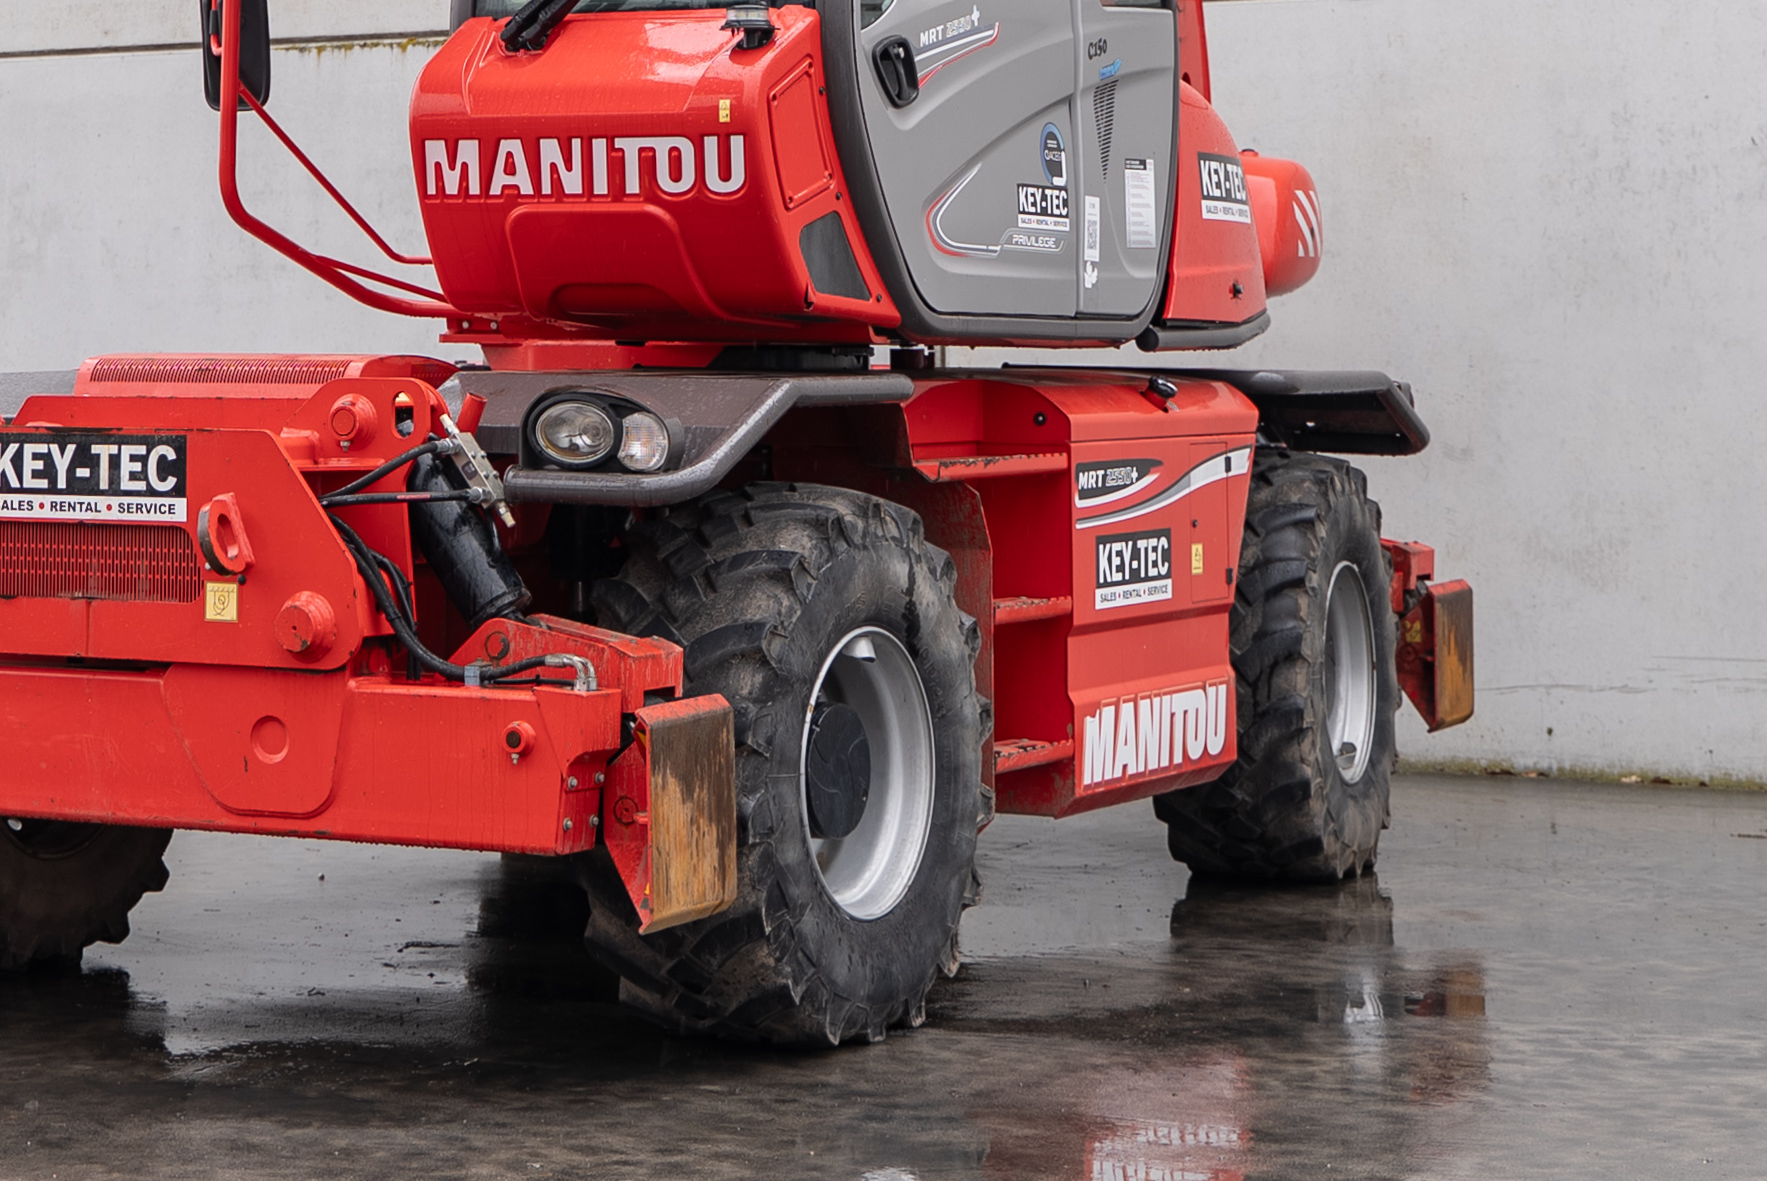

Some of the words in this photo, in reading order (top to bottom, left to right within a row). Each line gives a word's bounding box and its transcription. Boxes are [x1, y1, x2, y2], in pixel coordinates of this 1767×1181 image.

[919, 24, 945, 48] MRT
[1087, 37, 1108, 60] C150
[424, 135, 746, 196] MANITOU
[1199, 159, 1247, 202] KEY-TEC
[1018, 185, 1068, 216] KEY-TEC
[1011, 234, 1057, 248] PRIVILEGE
[1078, 469, 1105, 491] MRT
[49, 500, 102, 513] RENTAL
[117, 502, 176, 515] SERVICE
[1098, 536, 1169, 584] KEY-TEC
[1099, 592, 1117, 603] SALES
[1122, 588, 1142, 600] RENTAL
[1147, 584, 1168, 596] SERVICE
[1083, 683, 1228, 786] MANITOU
